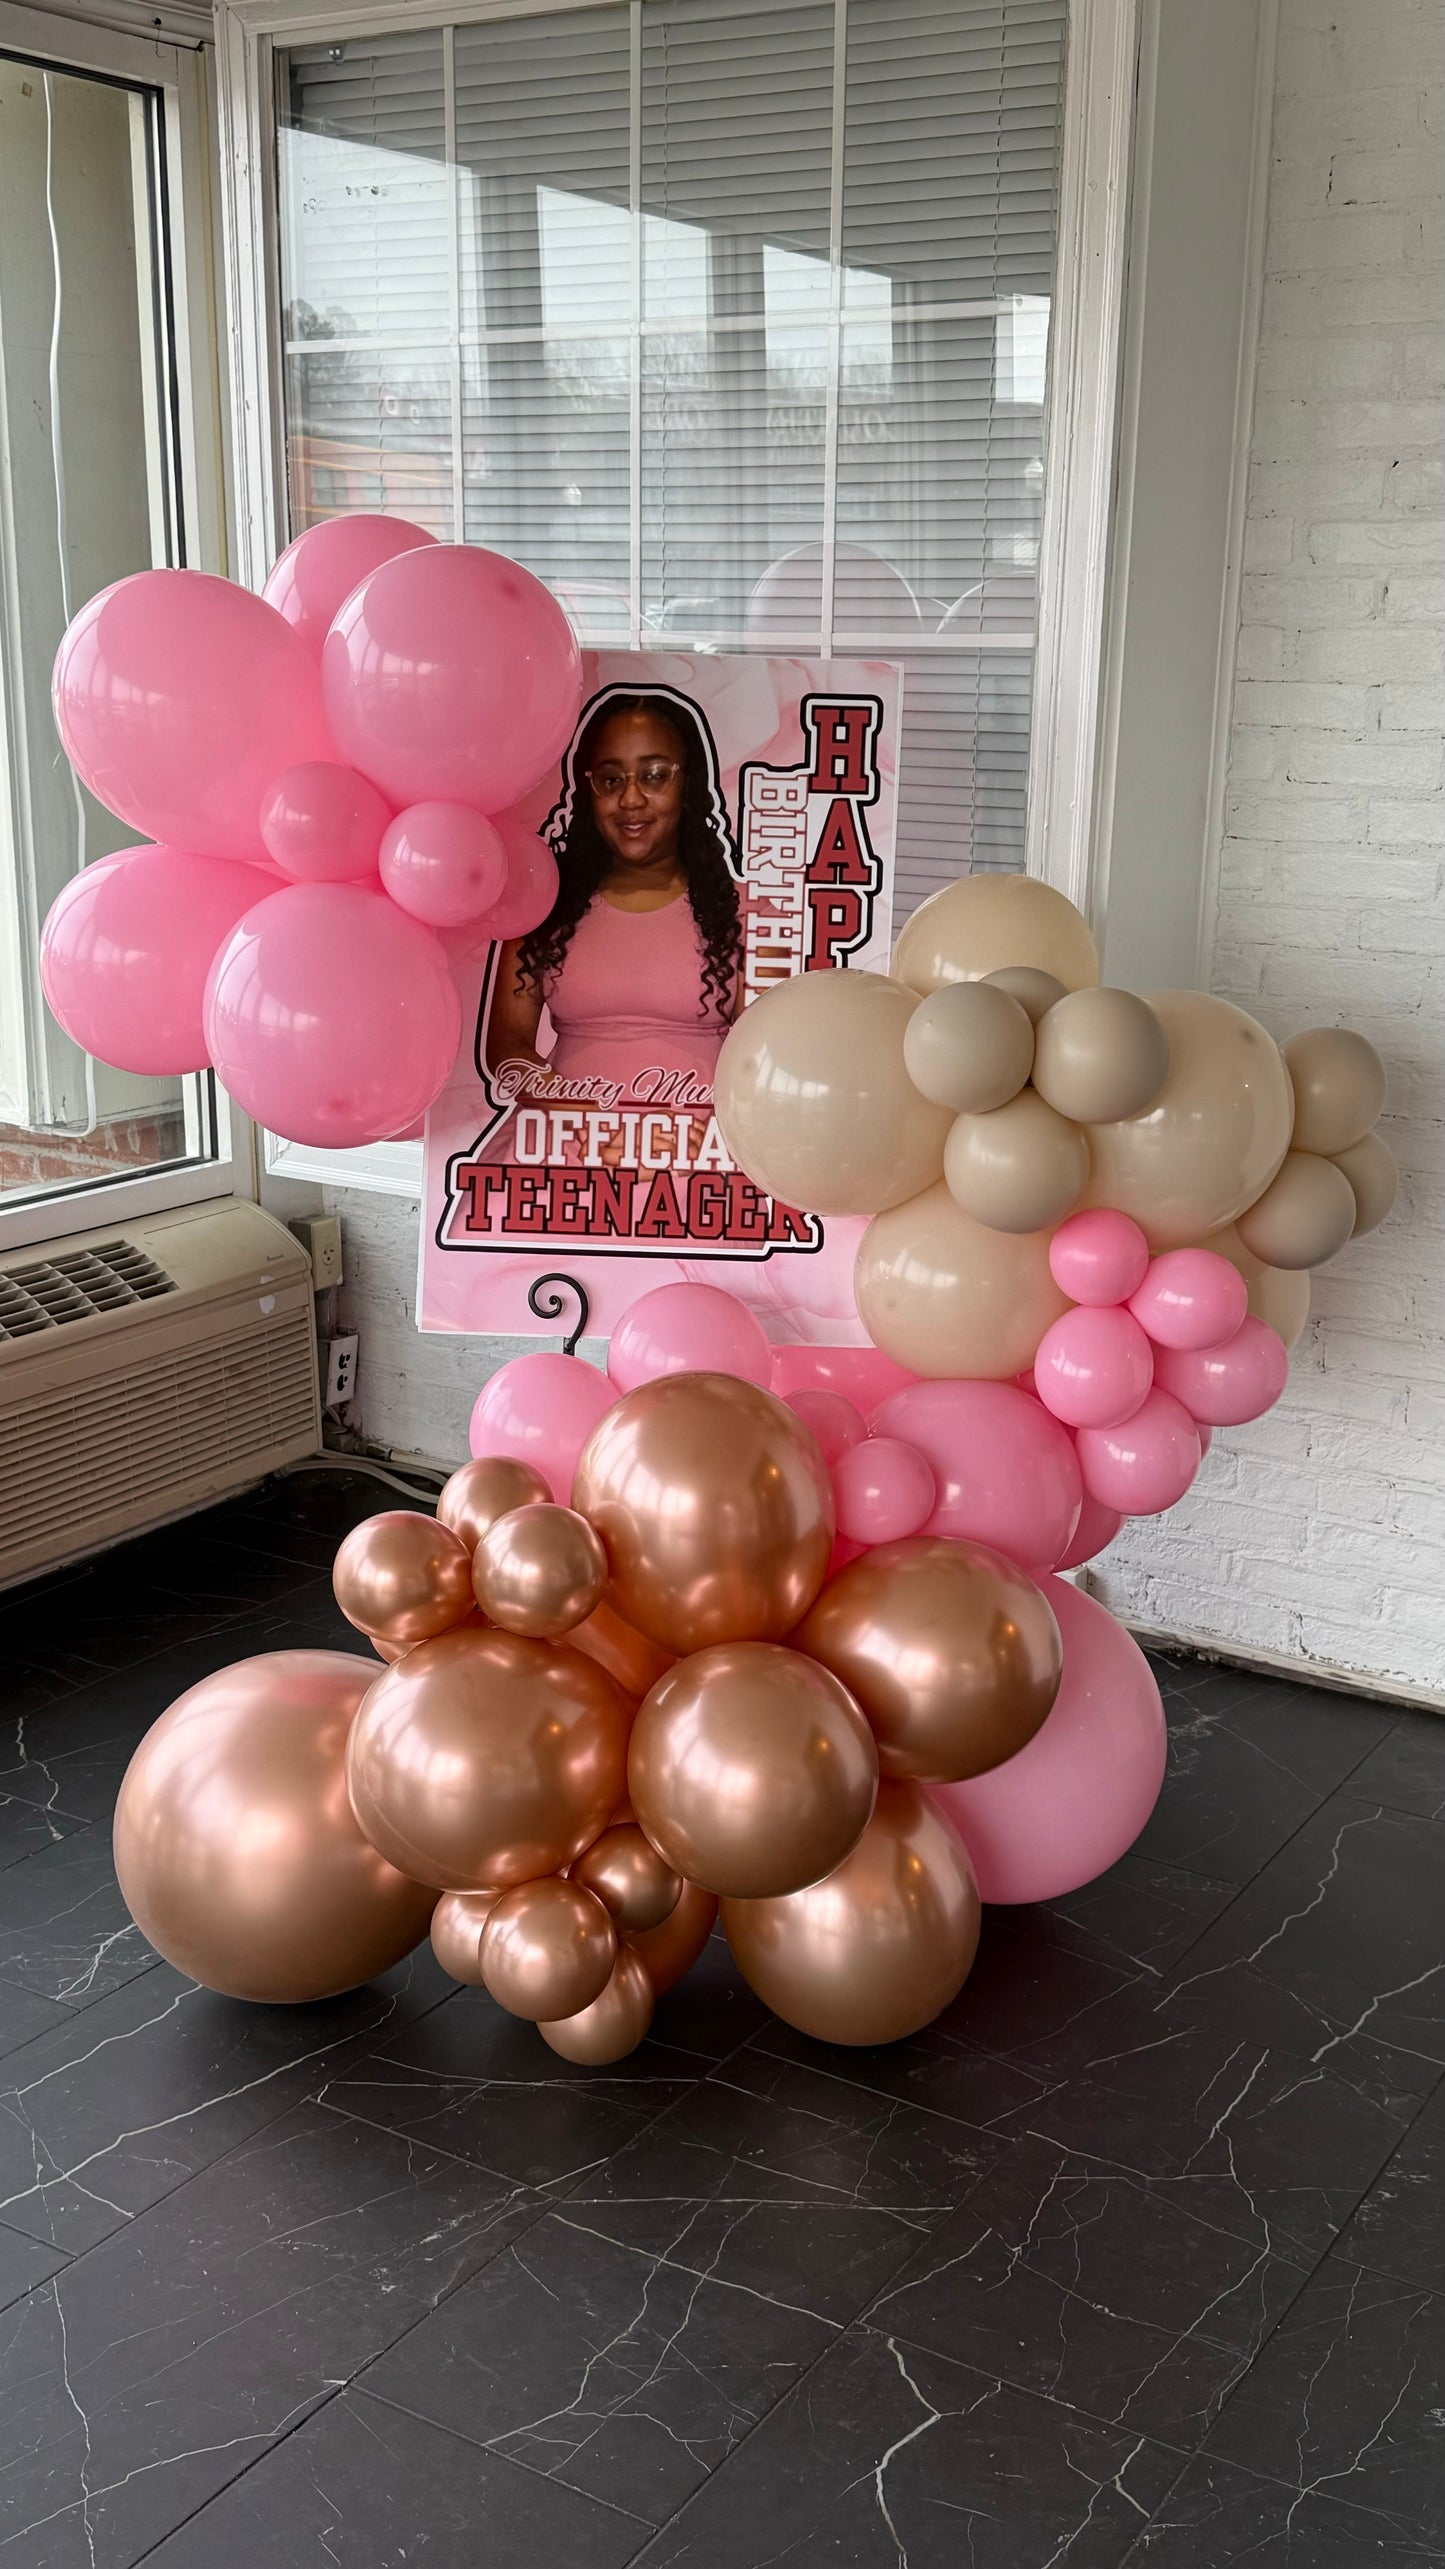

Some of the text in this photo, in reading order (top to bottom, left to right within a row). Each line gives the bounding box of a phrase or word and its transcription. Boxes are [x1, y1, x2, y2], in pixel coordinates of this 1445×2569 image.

[743, 772, 809, 1007] BIRTHD
[805, 705, 873, 973] HAP
[495, 1060, 714, 1110] Trinity Mu
[514, 1109, 741, 1173] OFFICIA
